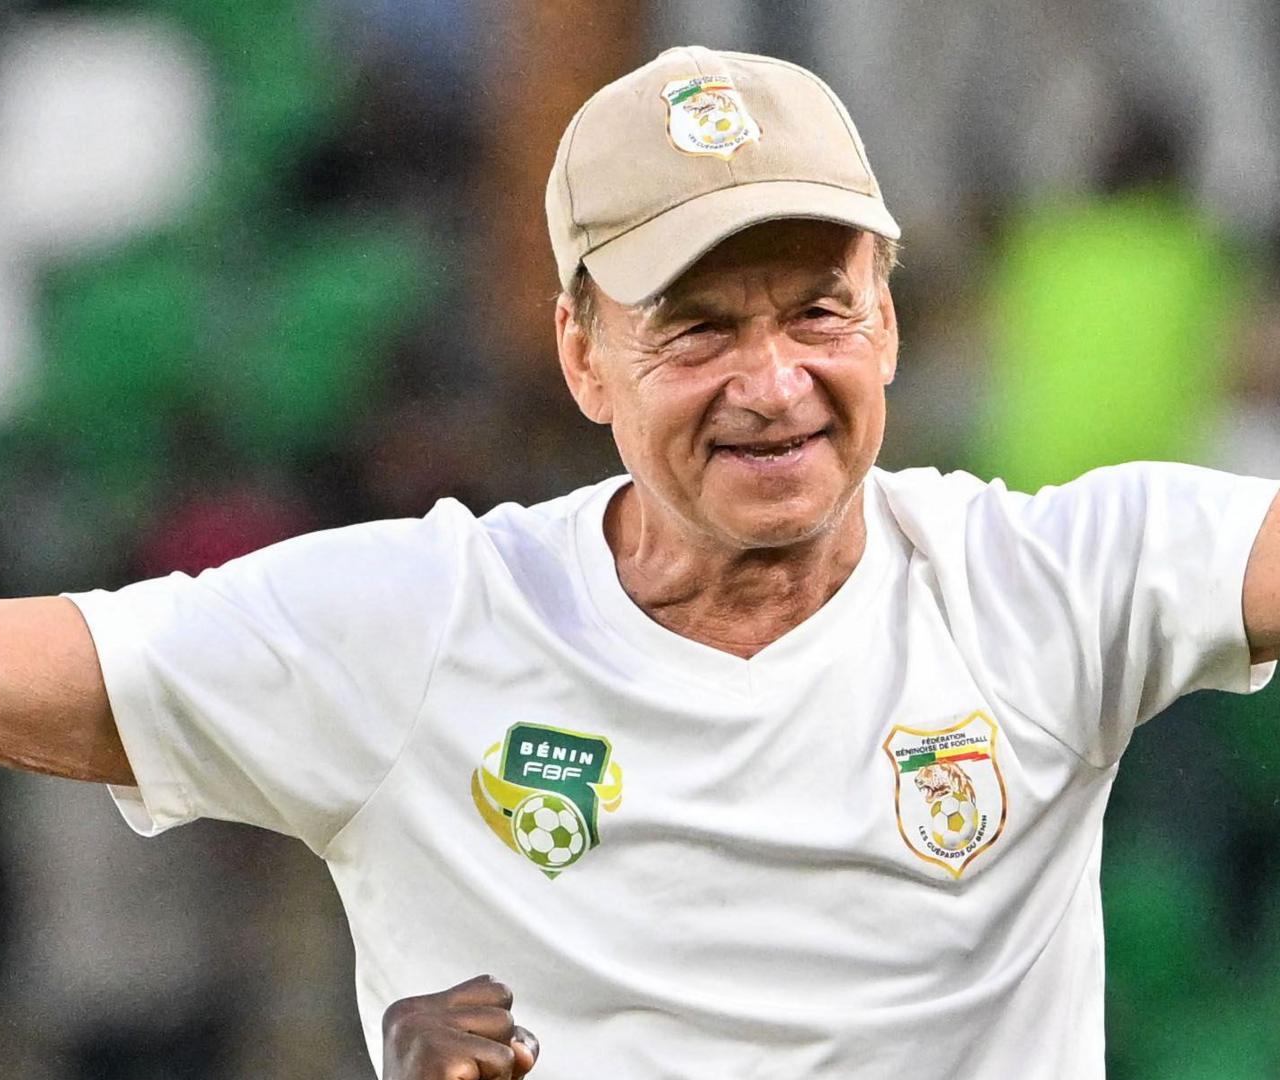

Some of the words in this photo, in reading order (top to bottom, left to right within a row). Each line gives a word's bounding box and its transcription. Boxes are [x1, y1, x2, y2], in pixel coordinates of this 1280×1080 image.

[895, 744, 937, 757] BÉNINOISE
[939, 741, 950, 750] DE
[950, 735, 988, 747] FOOTBALL
[921, 732, 966, 745] FÉDÉRATION
[519, 741, 594, 765] BÉNIN
[523, 761, 583, 781] FBF
[918, 825, 929, 842] LES
[966, 843, 977, 853] DU
